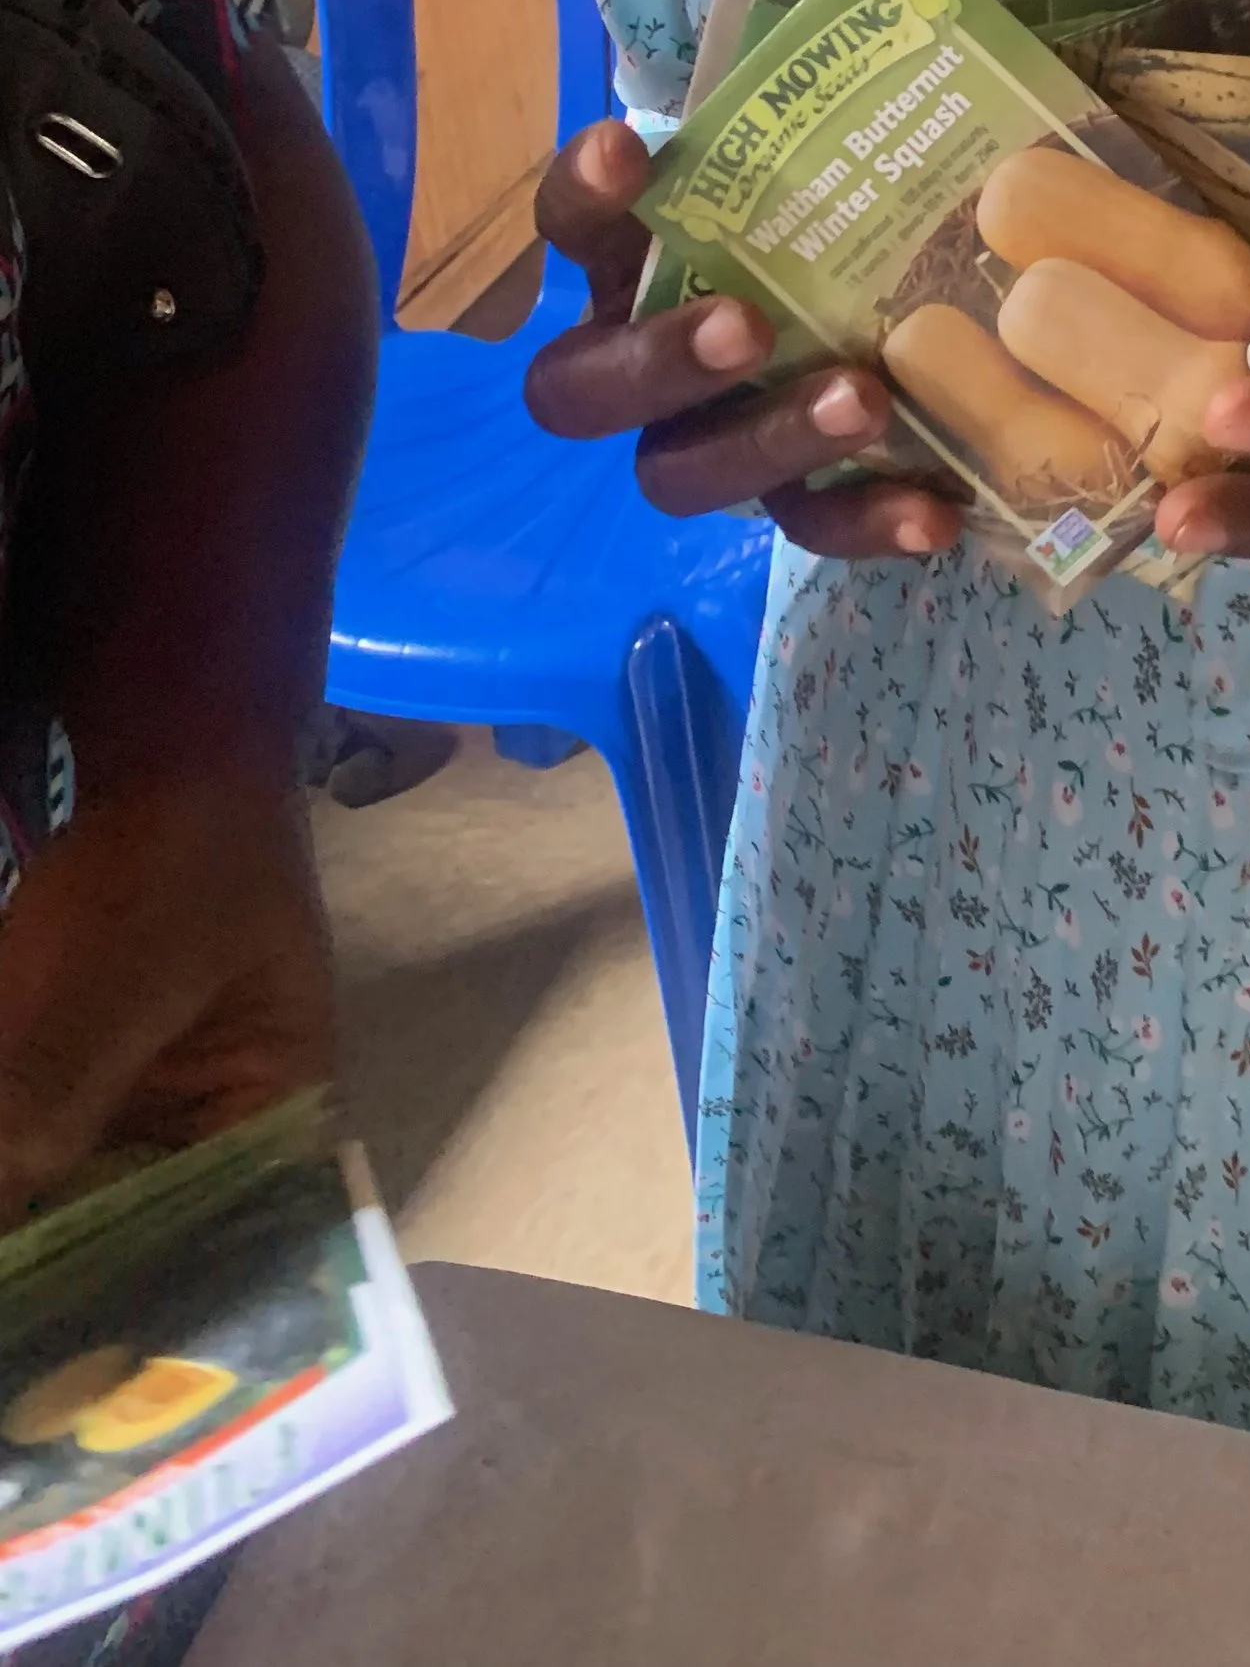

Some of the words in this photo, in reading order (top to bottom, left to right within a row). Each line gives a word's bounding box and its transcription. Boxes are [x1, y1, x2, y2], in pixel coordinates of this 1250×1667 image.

[689, 112, 769, 210] HIGH
[746, 158, 852, 254] Waltham
[842, 44, 964, 160] Butternut
[789, 178, 880, 262] Winter
[873, 90, 973, 183] Squash
